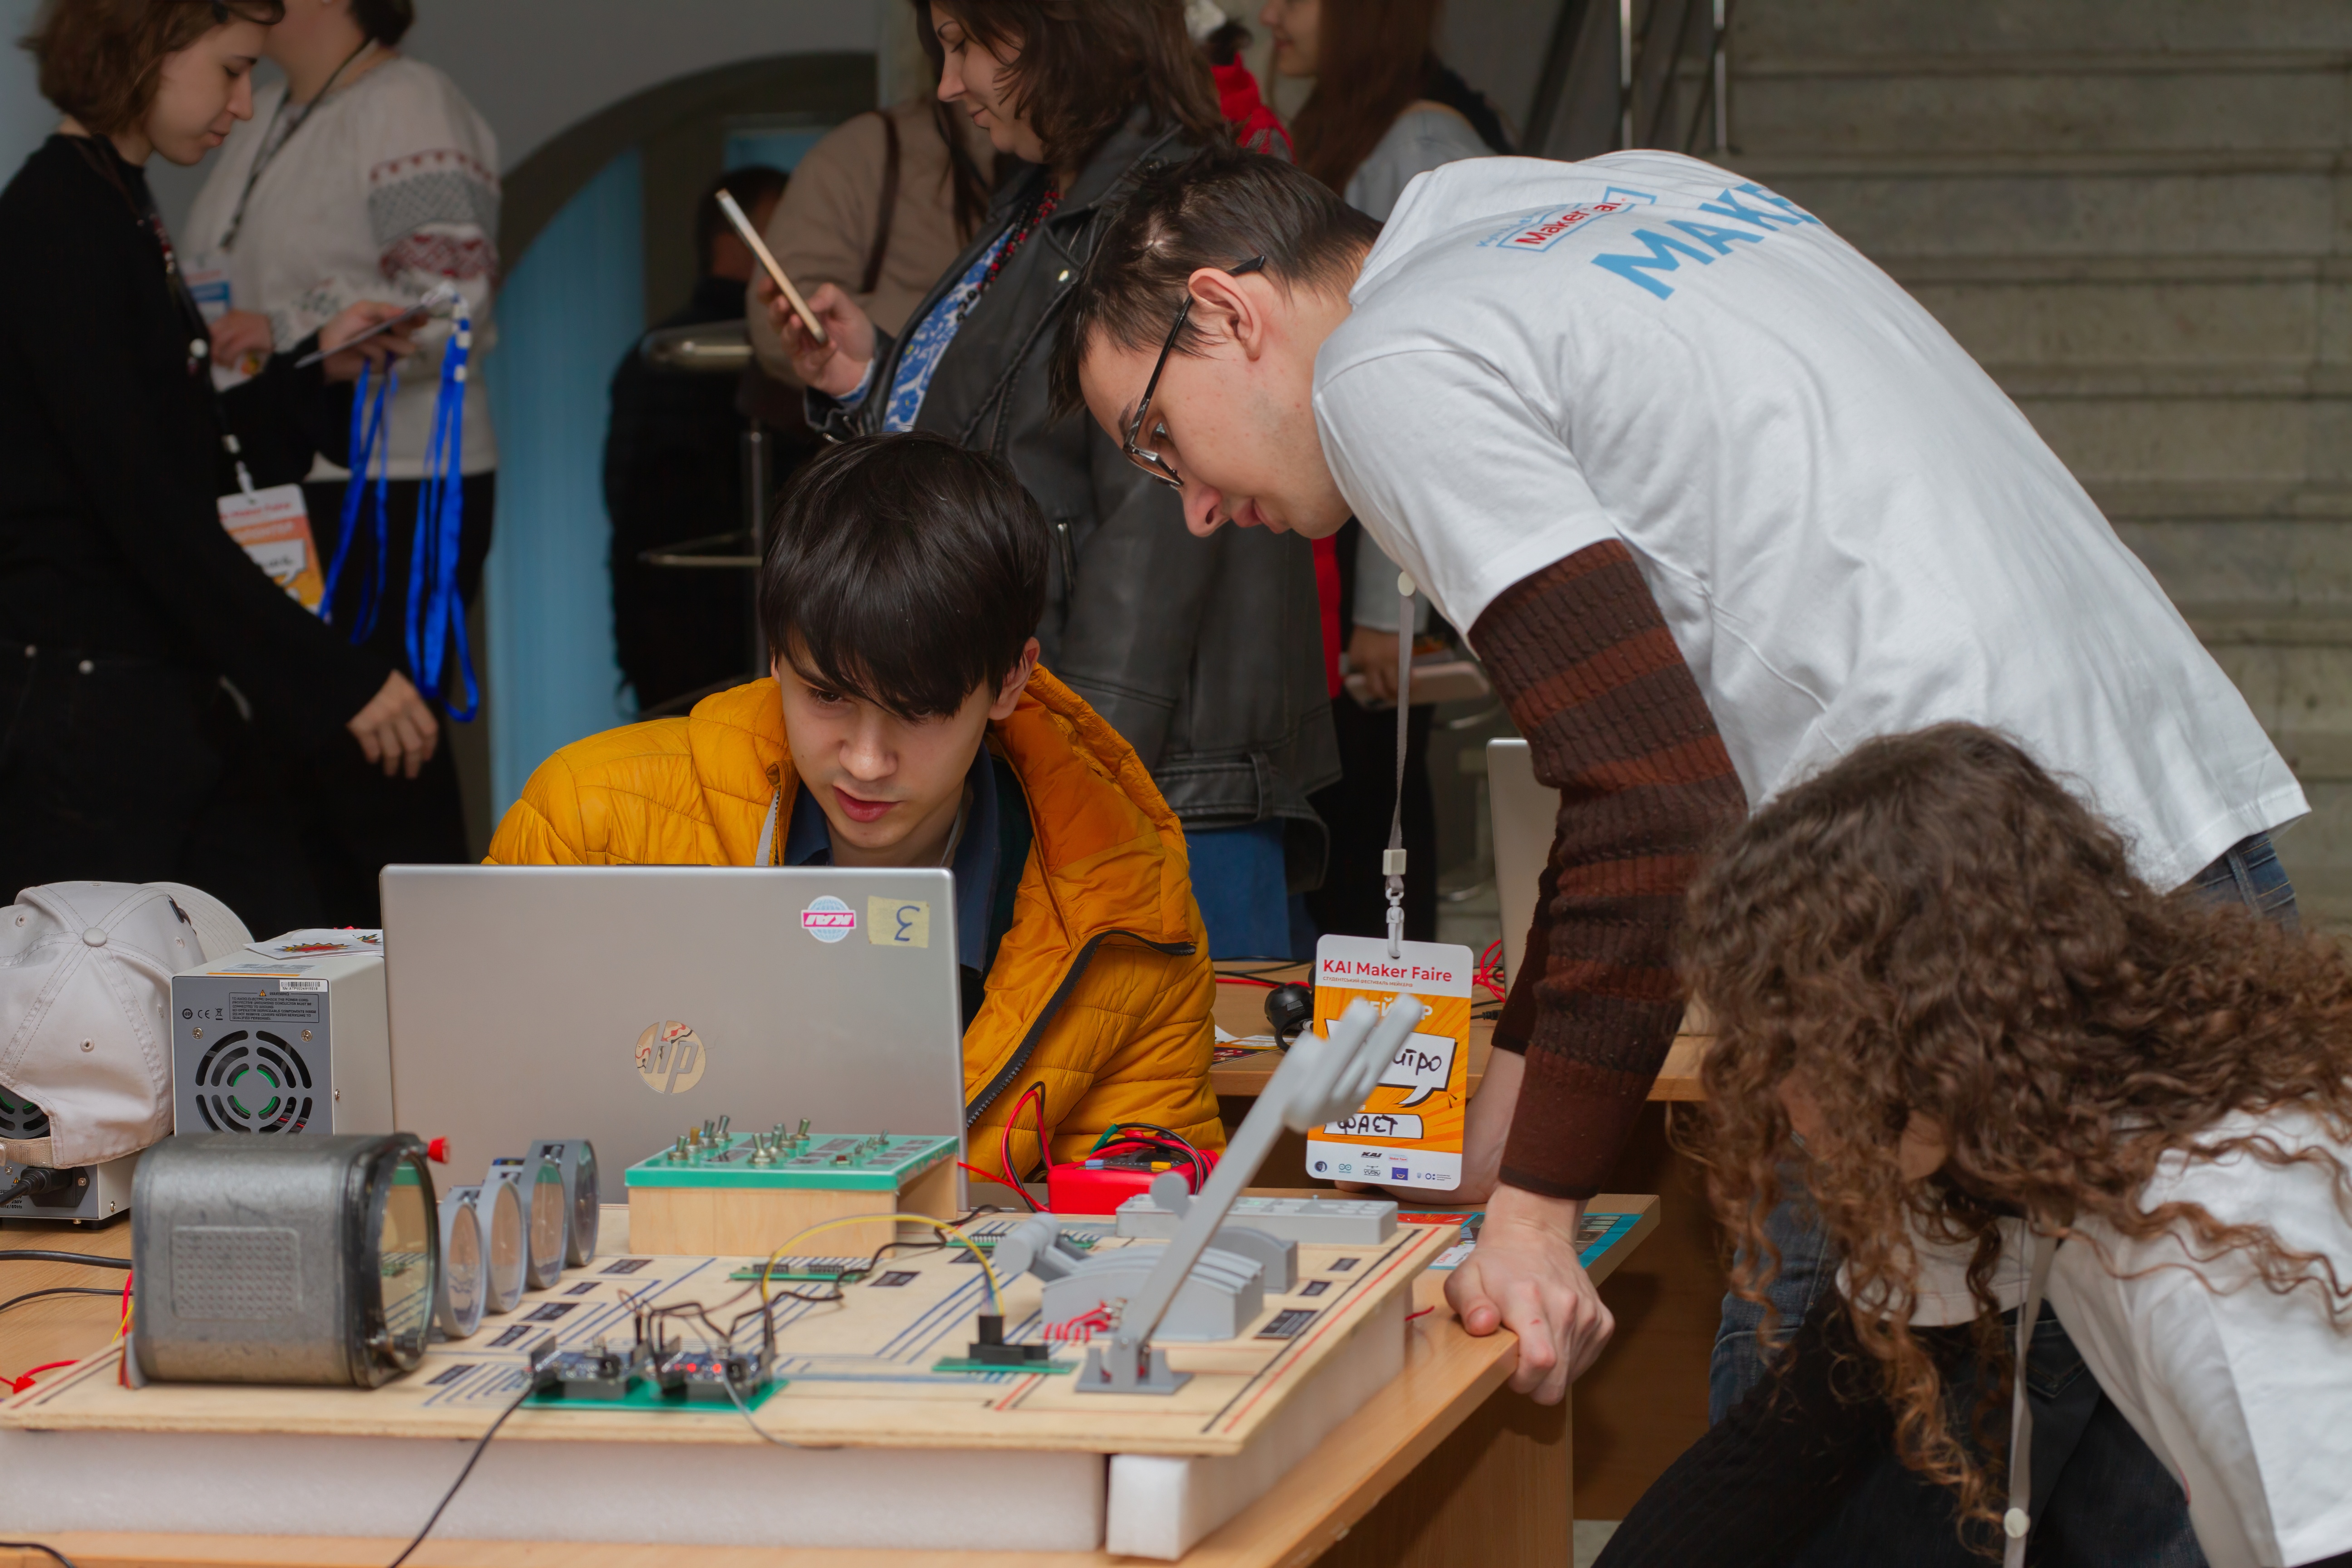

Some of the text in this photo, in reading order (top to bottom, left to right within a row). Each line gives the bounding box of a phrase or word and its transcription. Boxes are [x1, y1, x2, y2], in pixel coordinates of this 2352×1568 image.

[1514, 210, 1590, 245] Maker
[1323, 959, 1452, 982] KAI Maker Faire
[644, 1020, 699, 1094] hp
